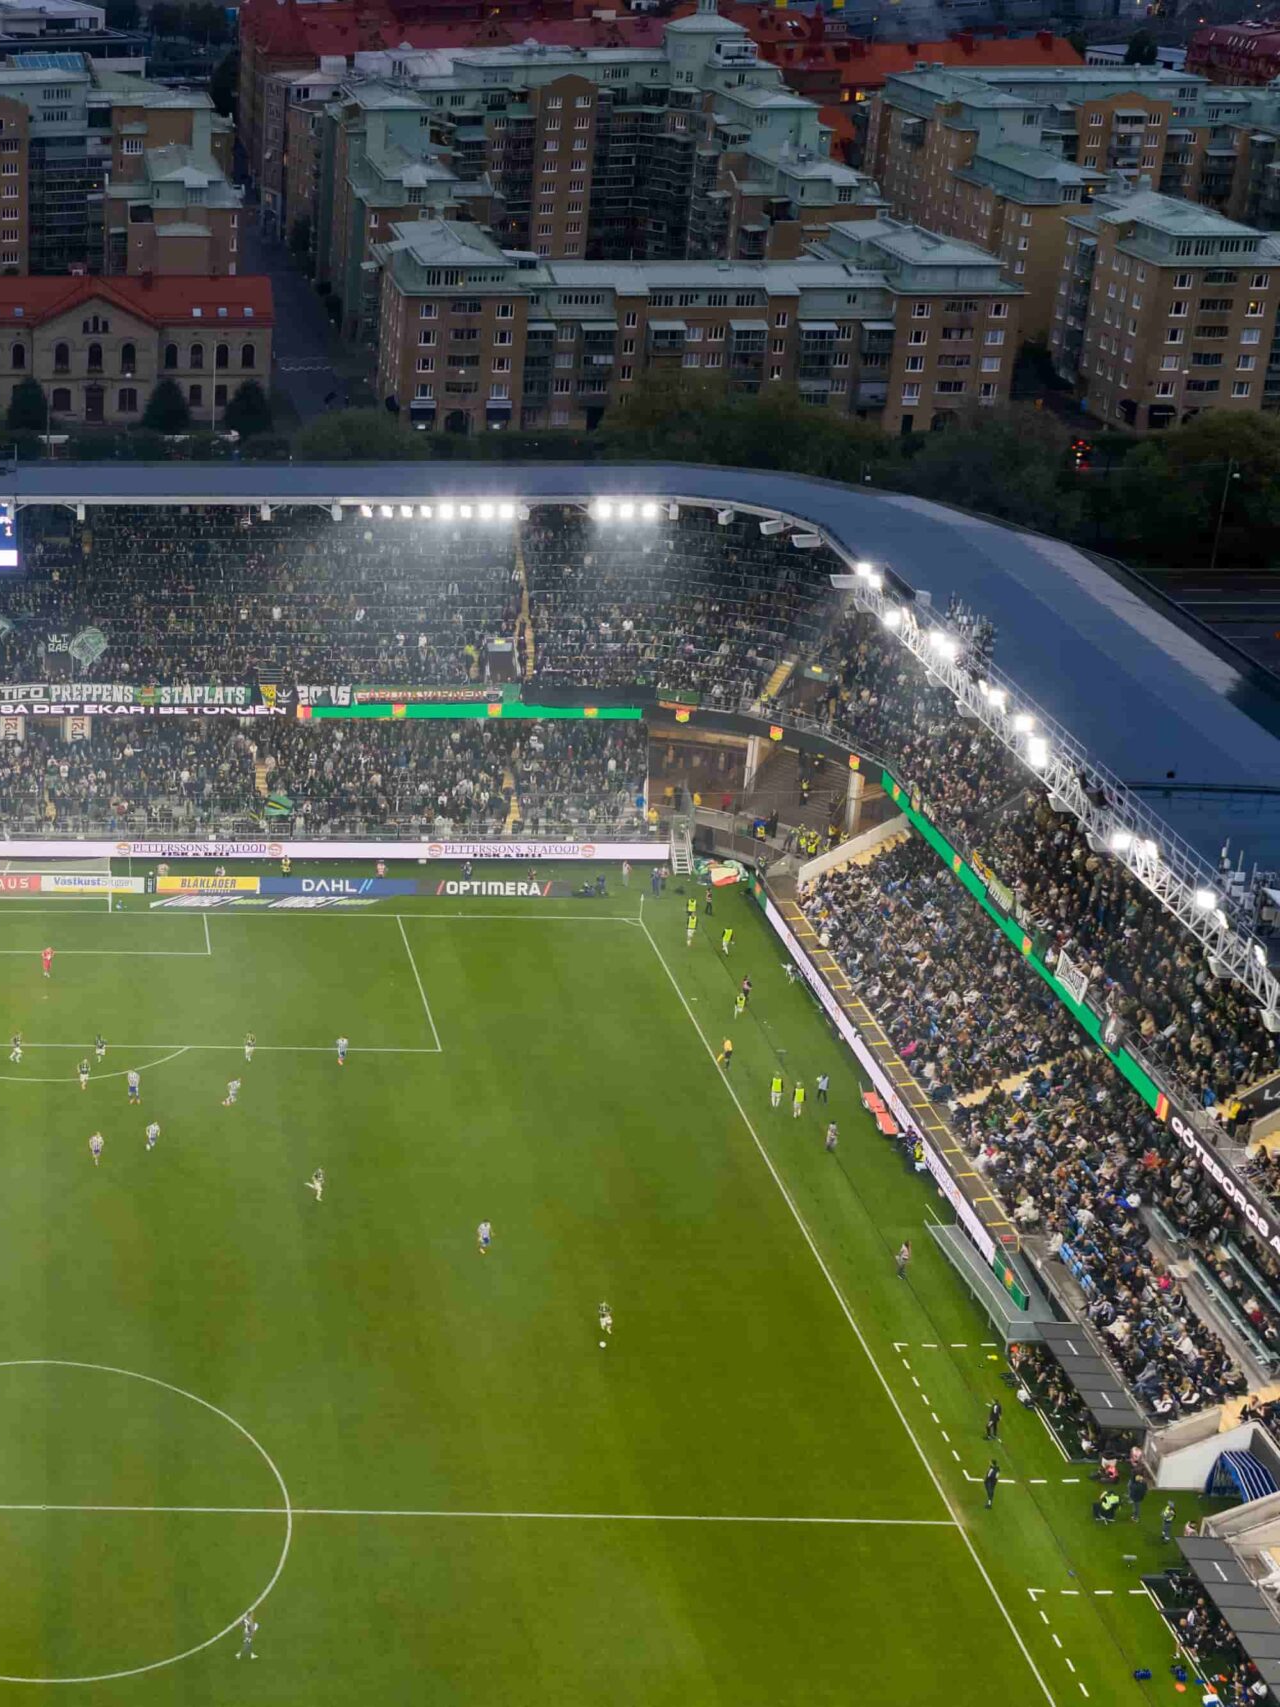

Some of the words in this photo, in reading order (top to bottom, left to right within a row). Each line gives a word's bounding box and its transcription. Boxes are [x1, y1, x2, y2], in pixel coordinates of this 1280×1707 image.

[5, 526, 12, 536] 1
[1, 687, 43, 699] TIFO
[51, 684, 133, 702] PREPPENS
[33, 705, 79, 714] DET
[83, 705, 140, 714] EKAR
[133, 843, 209, 852] PETTERSSONS
[215, 843, 266, 853] SEAFOOD
[444, 844, 521, 854] PETTERSSONS
[527, 844, 579, 854] SEAFOOD
[302, 879, 357, 892] DAHL
[446, 881, 541, 895] OPTIMERA
